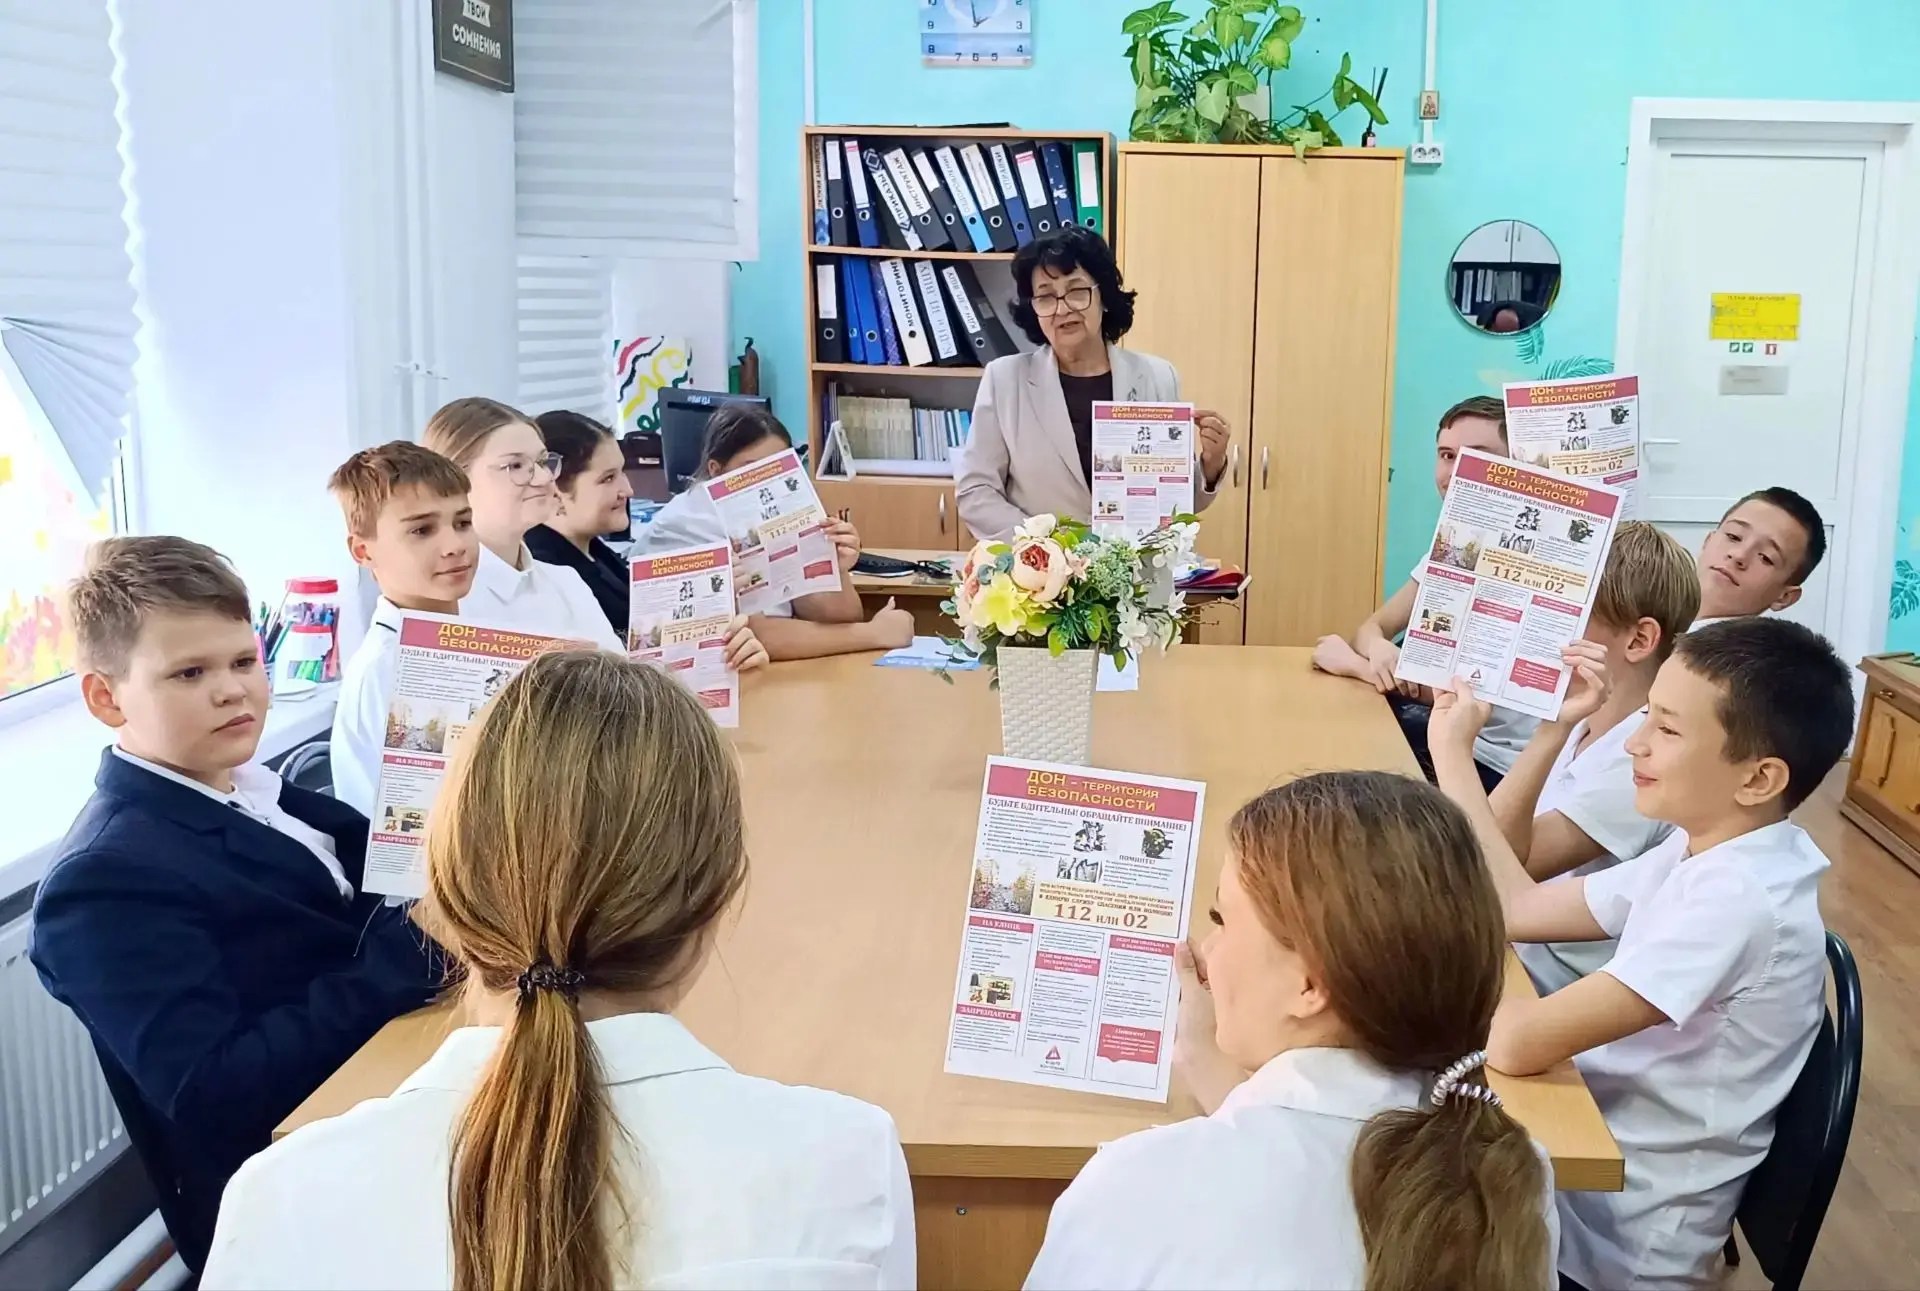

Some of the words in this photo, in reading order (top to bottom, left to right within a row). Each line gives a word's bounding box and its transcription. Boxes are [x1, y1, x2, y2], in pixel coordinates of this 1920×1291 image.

[928, 20, 934, 30] 9
[1016, 20, 1022, 30] 3
[452, 24, 501, 60] СОМНЕНИЯ
[928, 44, 935, 54] 8
[1017, 44, 1023, 53] 4
[955, 53, 962, 61] 7
[972, 53, 979, 62] 6
[992, 53, 998, 61] 5
[894, 156, 924, 210] ИНСТРУКТАЖ
[878, 174, 904, 219] ПРИКАЗЫ
[890, 261, 914, 327] МОНИТОРИНГ
[1529, 386, 1554, 396] ДОН
[1565, 382, 1616, 393] ТЕРРИТОРИЯ
[1531, 390, 1616, 404] БЕЗОПАСНОСТИ
[1564, 465, 1588, 475] 112
[1608, 460, 1623, 470] 02
[1486, 463, 1517, 478] ДОН
[1530, 476, 1588, 498] ТЕРРИТОРИЯ
[1486, 474, 1585, 506] БЕЗОПАСНОСТИ
[770, 526, 786, 538] 112
[651, 558, 671, 568] ДОН
[652, 560, 714, 576] БЕЗОПАСНОСТИ
[1492, 566, 1522, 582] 112
[1544, 580, 1564, 594] 02
[438, 624, 476, 638] ДОН
[673, 632, 690, 643] 112
[705, 626, 717, 634] 02
[440, 637, 541, 657] БЕЗОПАСНОС
[1026, 770, 1066, 785] ДОН
[1082, 781, 1160, 799] ТЕРРИТОРИЯ
[1027, 785, 1156, 812] БЕЗОПАСНОСТИ
[988, 798, 1020, 810] БУДЬТЕ
[1020, 802, 1078, 816] БДИТЕЛЬНЫ!
[1080, 810, 1134, 824] ОБРАЩАЙТЕ
[1135, 816, 1187, 831] ВНИМАНИЕ!
[1054, 904, 1091, 921] 112
[1124, 912, 1148, 929] 02
[961, 1008, 1017, 1019] ЗАПРЕЩАЕТСЯ
